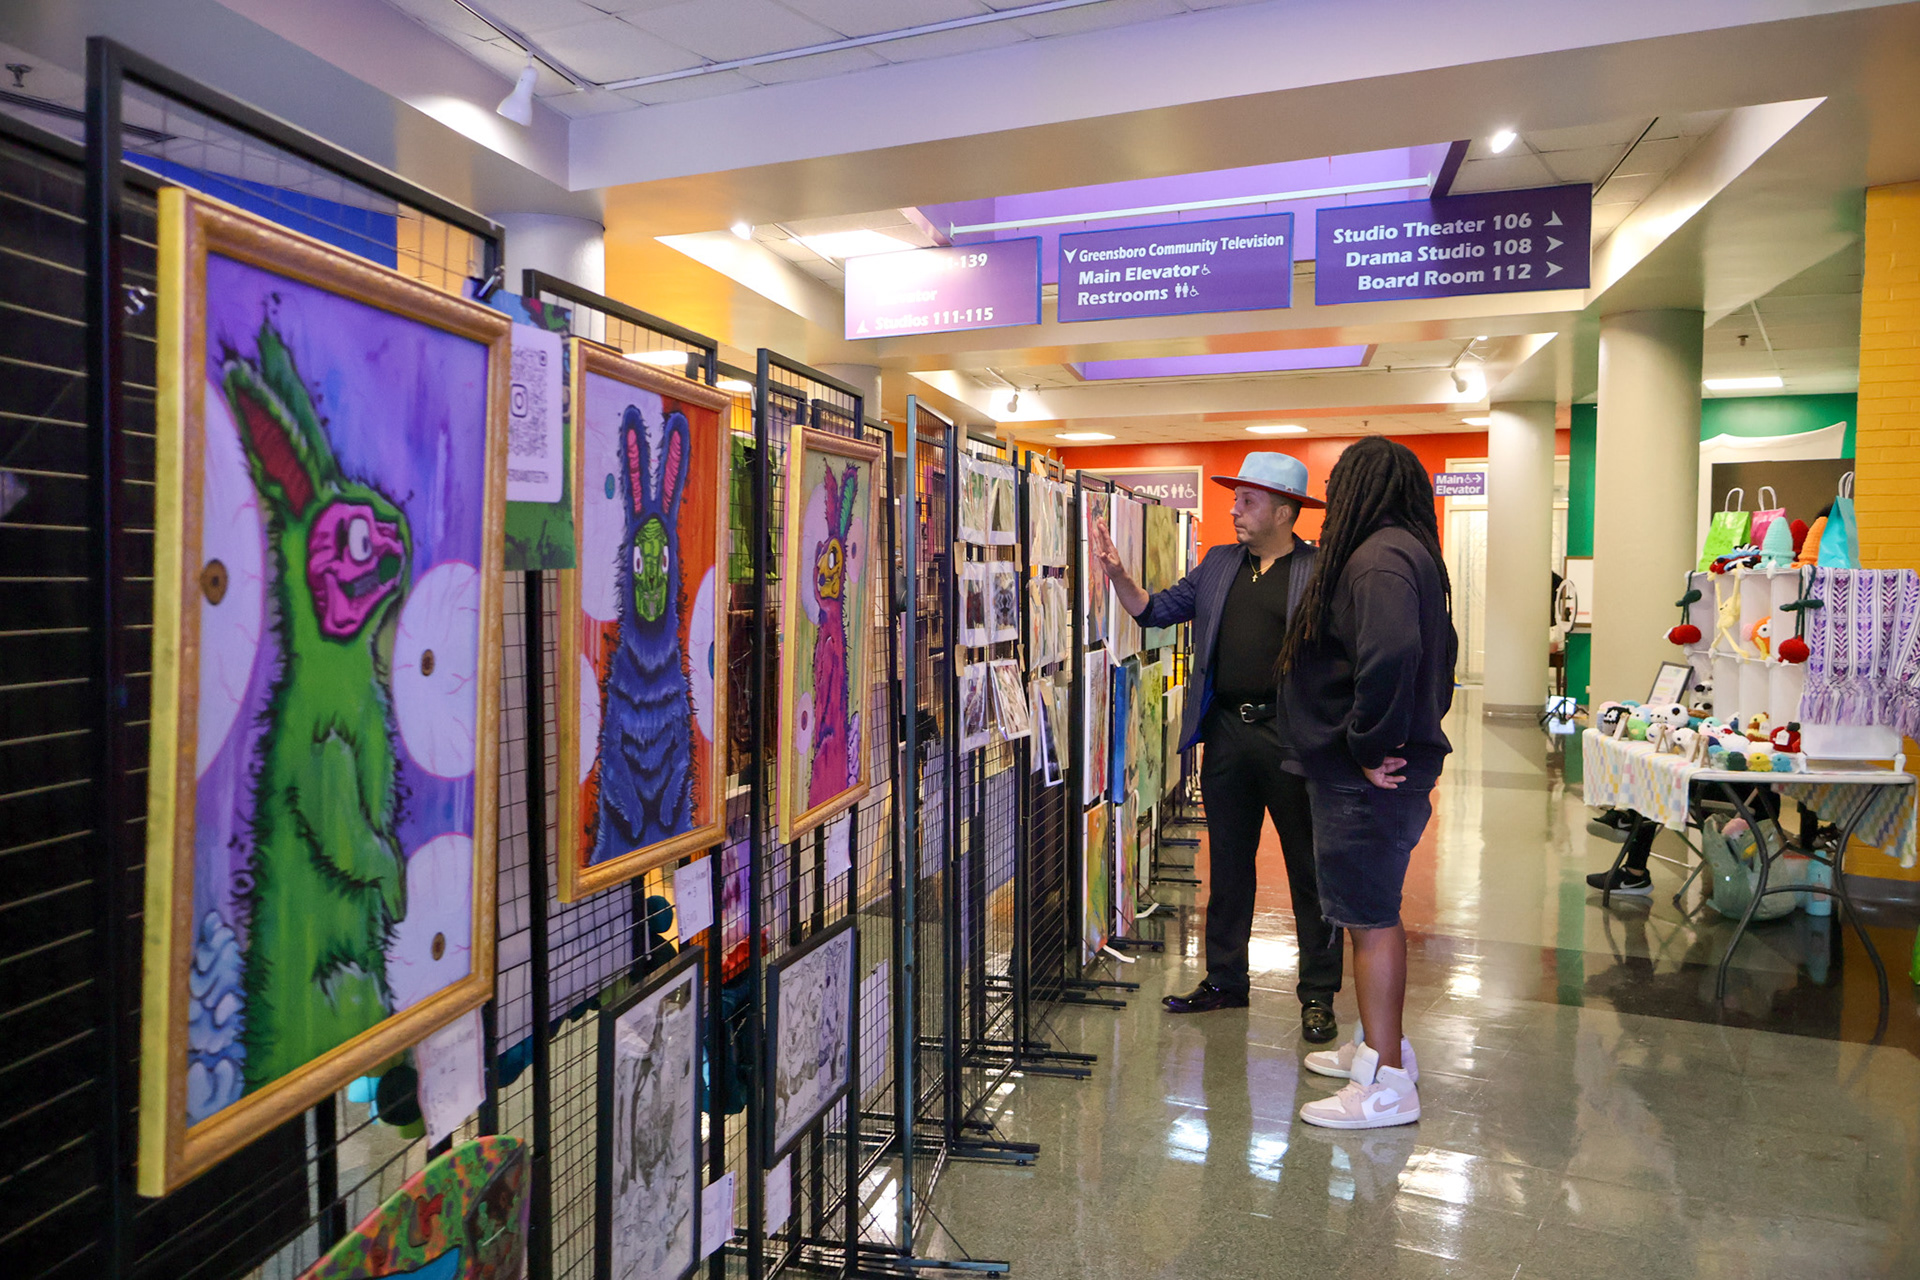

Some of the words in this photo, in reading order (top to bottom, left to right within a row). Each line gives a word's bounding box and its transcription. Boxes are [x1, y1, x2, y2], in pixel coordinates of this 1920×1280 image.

[1333, 224, 1398, 244] Studio
[1403, 218, 1485, 238] Theater
[1493, 212, 1532, 231] 106
[1078, 245, 1146, 263] Greensboro
[1149, 238, 1218, 257] Community
[1220, 233, 1284, 250] Television
[1345, 249, 1412, 267] Drama
[1417, 242, 1485, 262] Studio
[1493, 238, 1532, 256] 108
[1078, 268, 1121, 285] Main
[1125, 264, 1200, 282] Elevator
[1358, 271, 1419, 291] Board
[1424, 268, 1485, 286] Room
[1492, 263, 1531, 281] 112
[1077, 287, 1169, 306] Restrooms
[874, 312, 929, 331] Studios
[932, 306, 994, 326] 111-115
[1436, 474, 1464, 485] Main
[1436, 485, 1481, 495] Elevator
